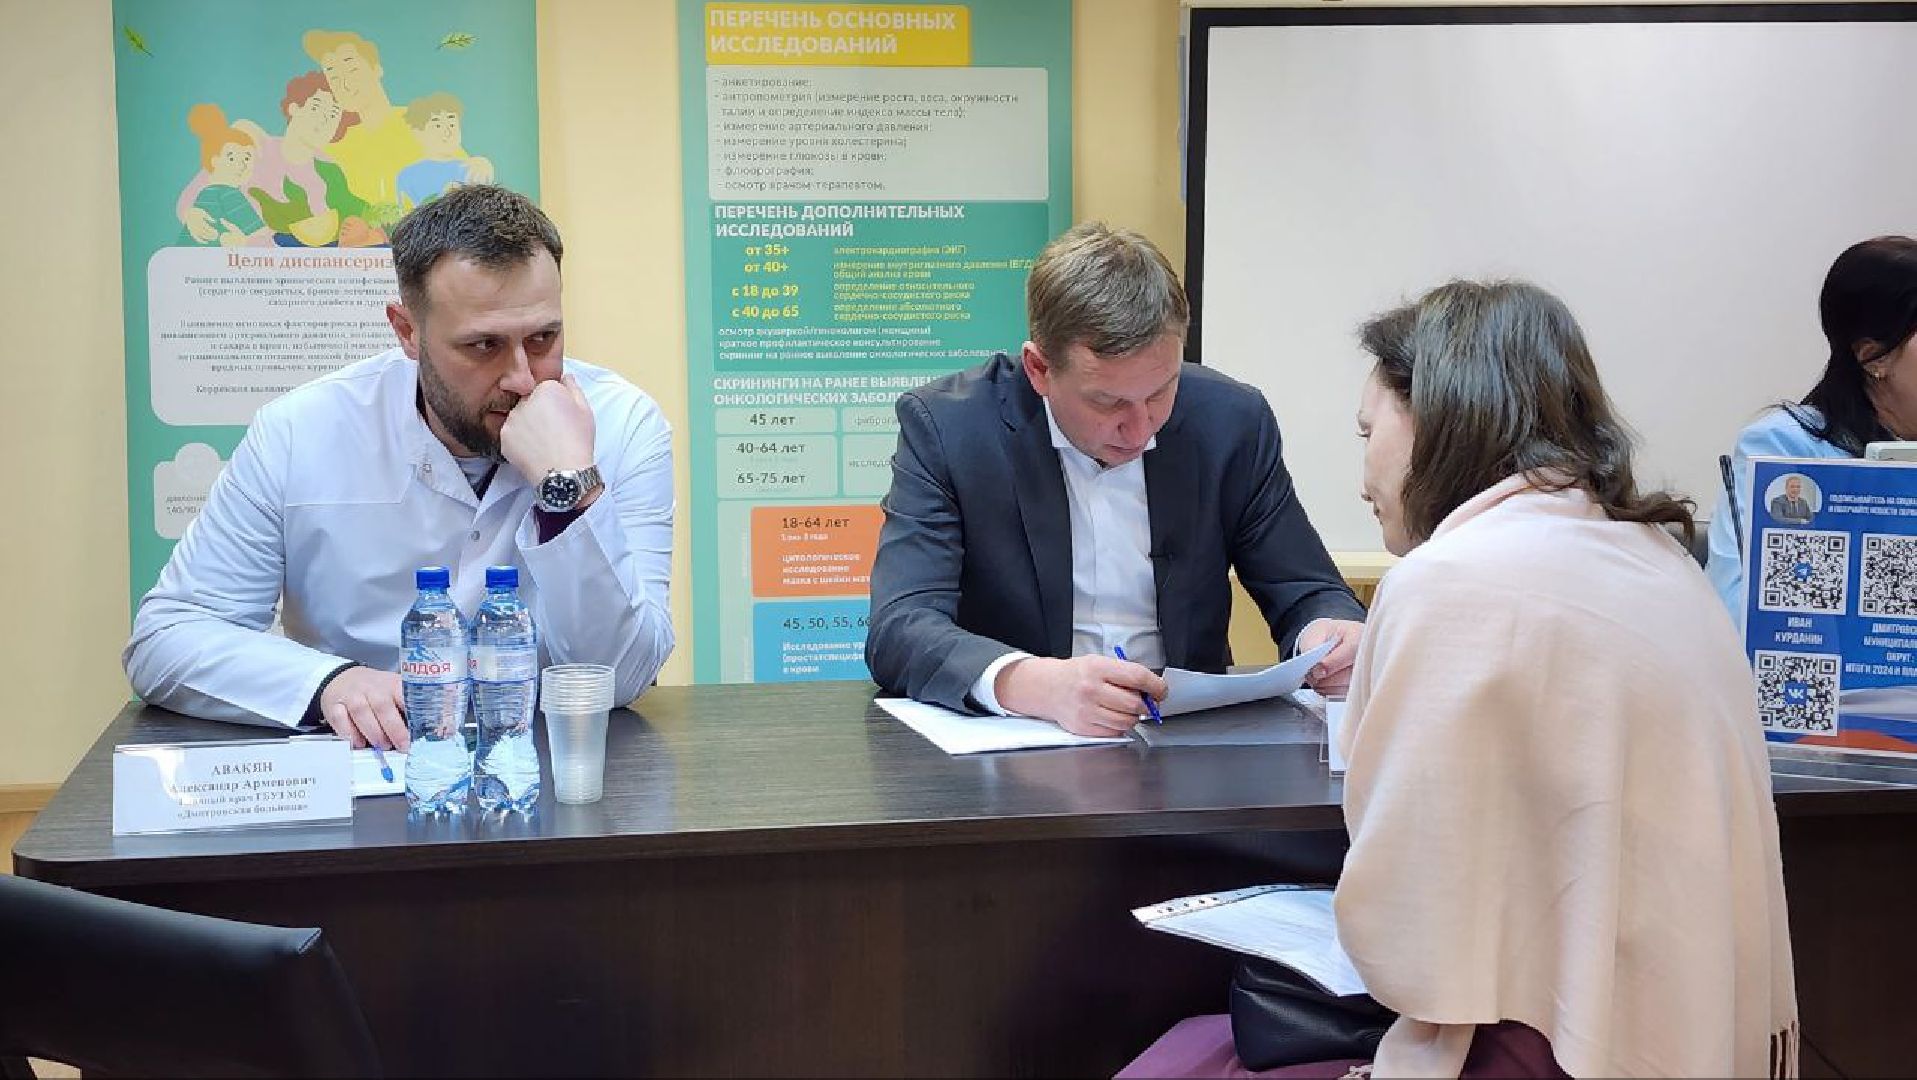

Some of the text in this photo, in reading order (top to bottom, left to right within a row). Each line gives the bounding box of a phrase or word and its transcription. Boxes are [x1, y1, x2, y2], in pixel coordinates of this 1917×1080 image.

[710, 9, 956, 30] ПЕРЕЧЕНЬ ОСНОВНЫХ
[710, 34, 898, 57] ИССЛЕДОВАНИЙ
[788, 123, 874, 133] артериального
[725, 182, 766, 191] осмотр
[714, 205, 965, 220] ПЕРЕЧЕНЬ ДОПОЛНИТЕЛЬНЫХ
[716, 221, 854, 239] ИССЛЕДОВАНИЙ
[745, 244, 790, 255] от 35+
[228, 253, 274, 269] Цели
[744, 262, 789, 272] от 40+
[731, 286, 799, 299] с 18 до 39
[731, 306, 799, 319] с 40 до 65
[714, 376, 936, 389] СКРИНИНГИ НА РАНЕЕ ВЫЯВЛЕ
[714, 392, 848, 405] ОНКОЛОГИЧЕСКИХ
[750, 413, 795, 426] 45 лет
[735, 442, 805, 453] 40-64 лет
[737, 472, 806, 484] 65-75 лет
[783, 517, 850, 528] 18-64 лет
[783, 617, 804, 630] 45,
[808, 617, 829, 630] 50,
[833, 616, 853, 629] 55,
[1787, 616, 1813, 628] ИВАН
[1775, 631, 1823, 645] КУРДАНИН
[212, 761, 273, 776] АВАКЯН
